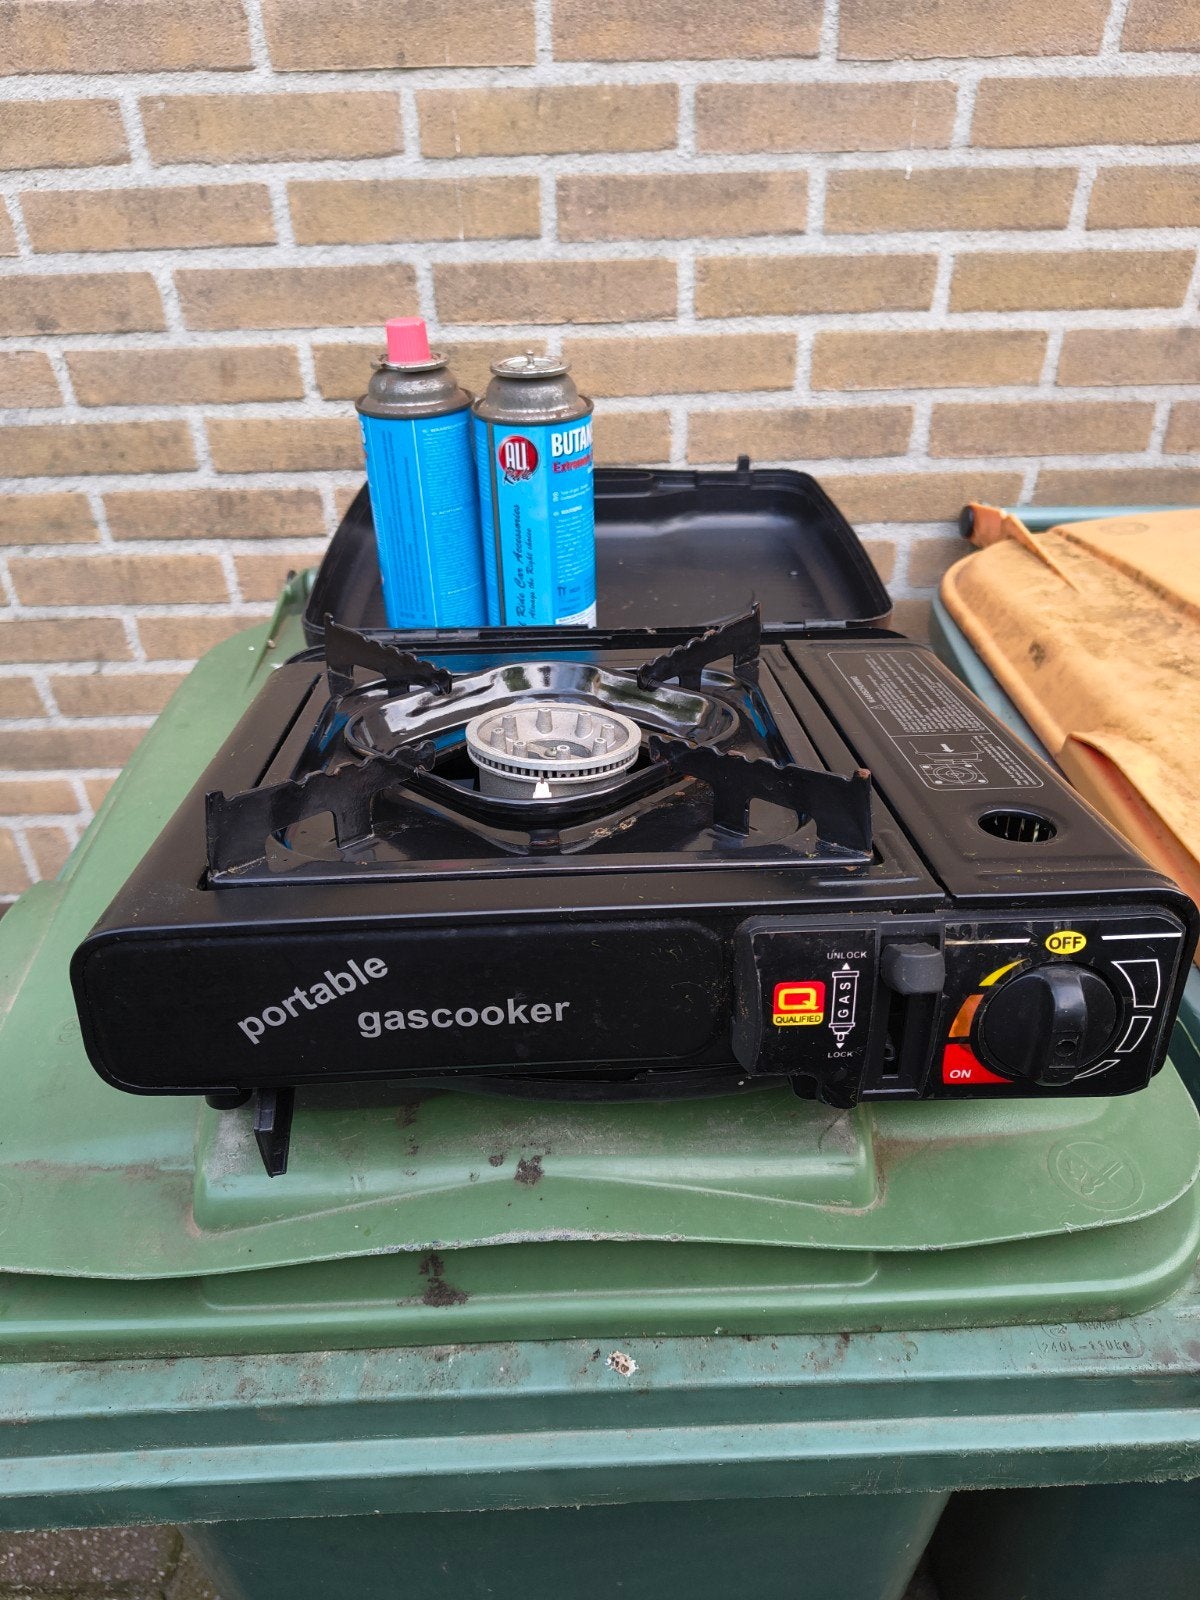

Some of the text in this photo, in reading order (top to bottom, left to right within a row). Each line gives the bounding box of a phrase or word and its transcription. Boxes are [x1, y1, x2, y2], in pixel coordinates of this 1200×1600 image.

[504, 441, 530, 470] ALL
[512, 504, 525, 565] Accessories
[525, 553, 535, 575] Right
[513, 567, 526, 589] Car
[527, 577, 535, 590] the
[515, 592, 526, 617] Ride
[528, 591, 537, 620] Always
[1048, 935, 1083, 950] OFF
[826, 951, 867, 960] UNLOCK
[237, 957, 389, 1045] portable
[777, 987, 819, 1011] Q
[837, 981, 852, 1018] GAS
[357, 998, 570, 1038] gascooker
[775, 1014, 822, 1024] QUALIFIED
[827, 1051, 854, 1059] LOCK
[949, 1069, 972, 1079] ON
